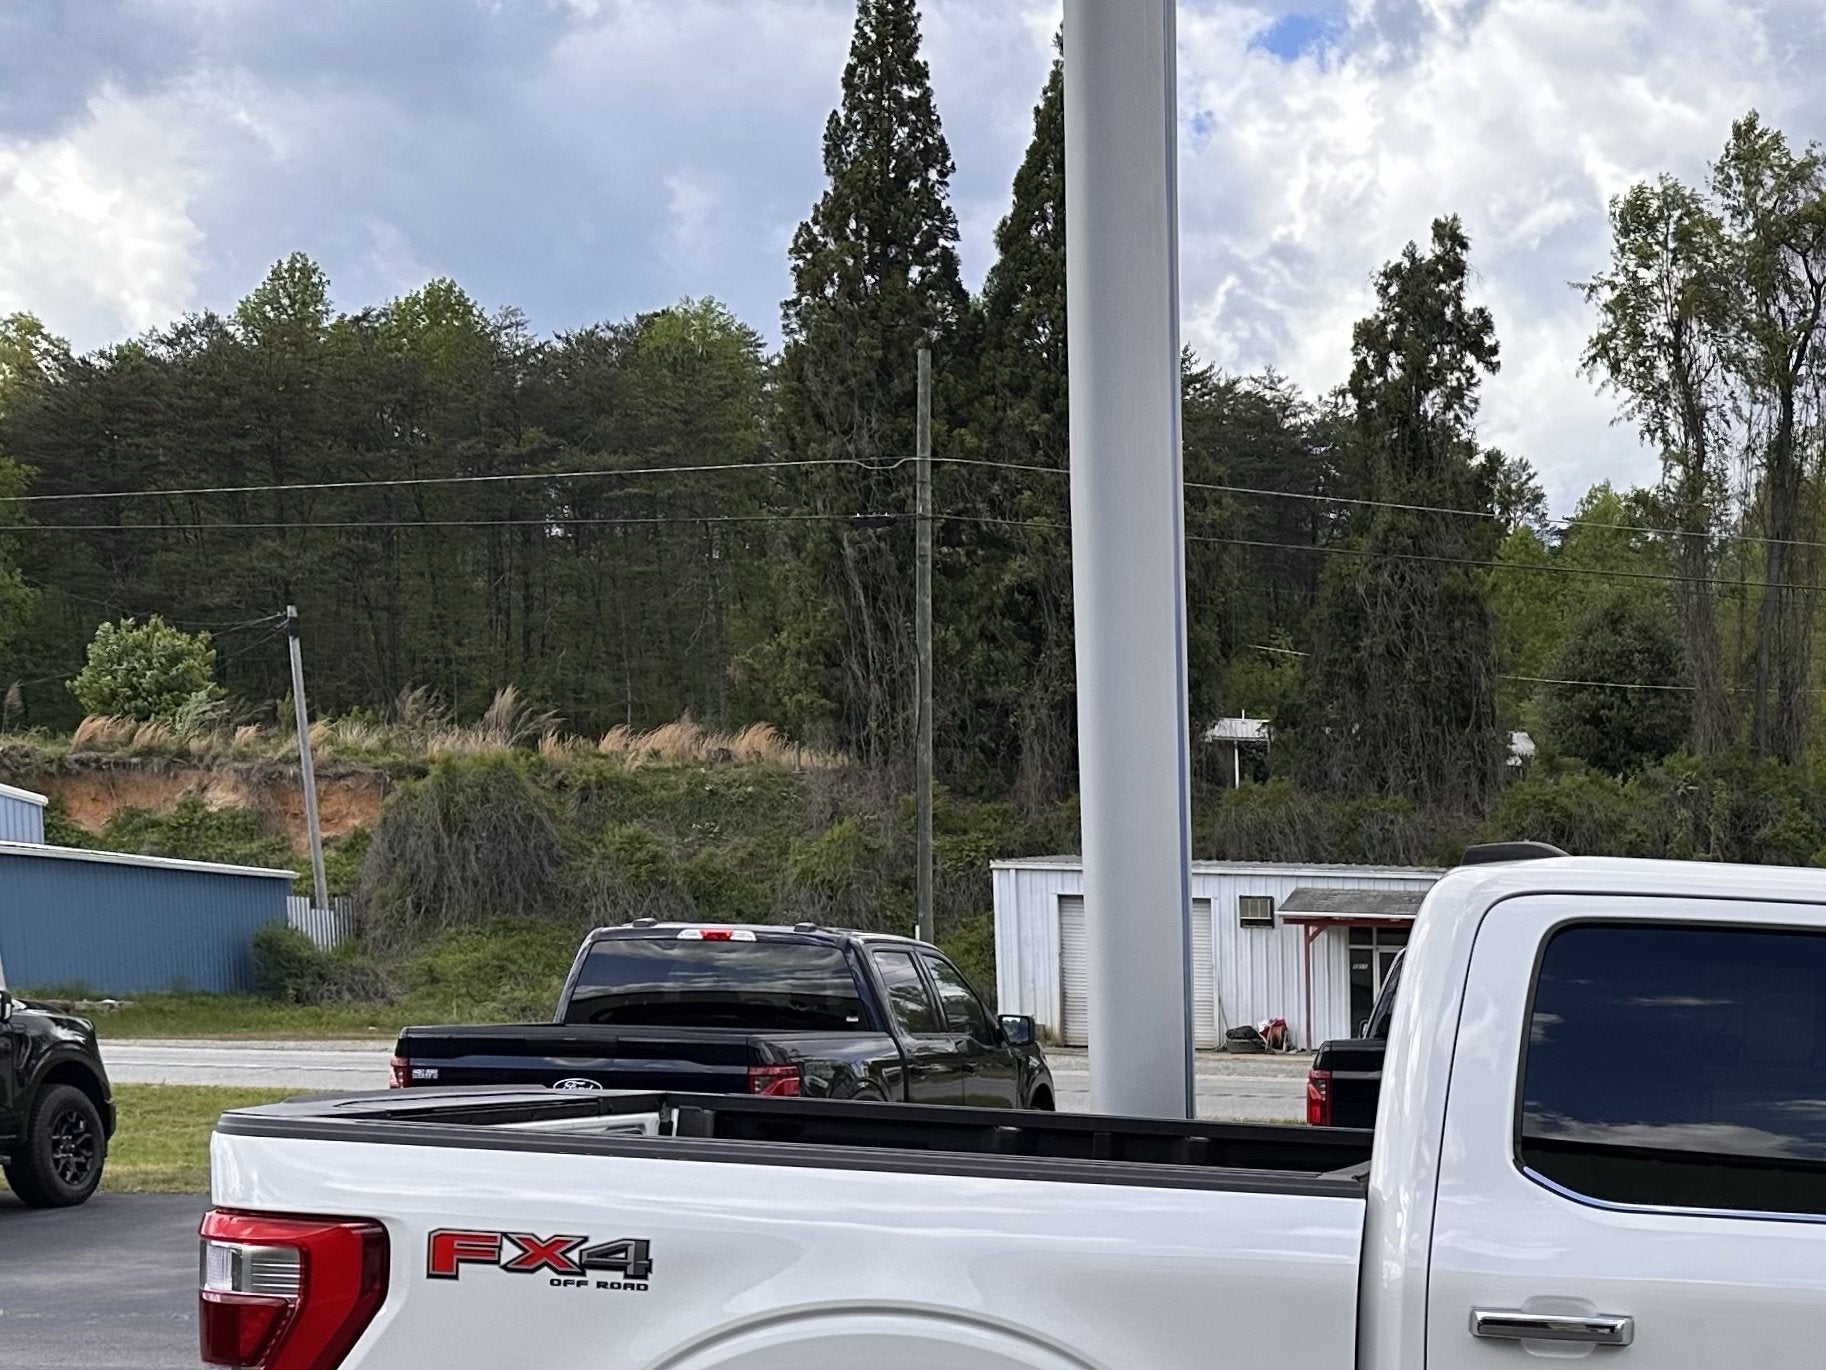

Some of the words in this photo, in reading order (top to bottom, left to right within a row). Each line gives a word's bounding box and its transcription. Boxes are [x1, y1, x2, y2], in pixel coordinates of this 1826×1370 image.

[427, 1228, 652, 1281] FX4
[550, 1278, 589, 1288] OFF
[596, 1281, 649, 1292] ROAD
